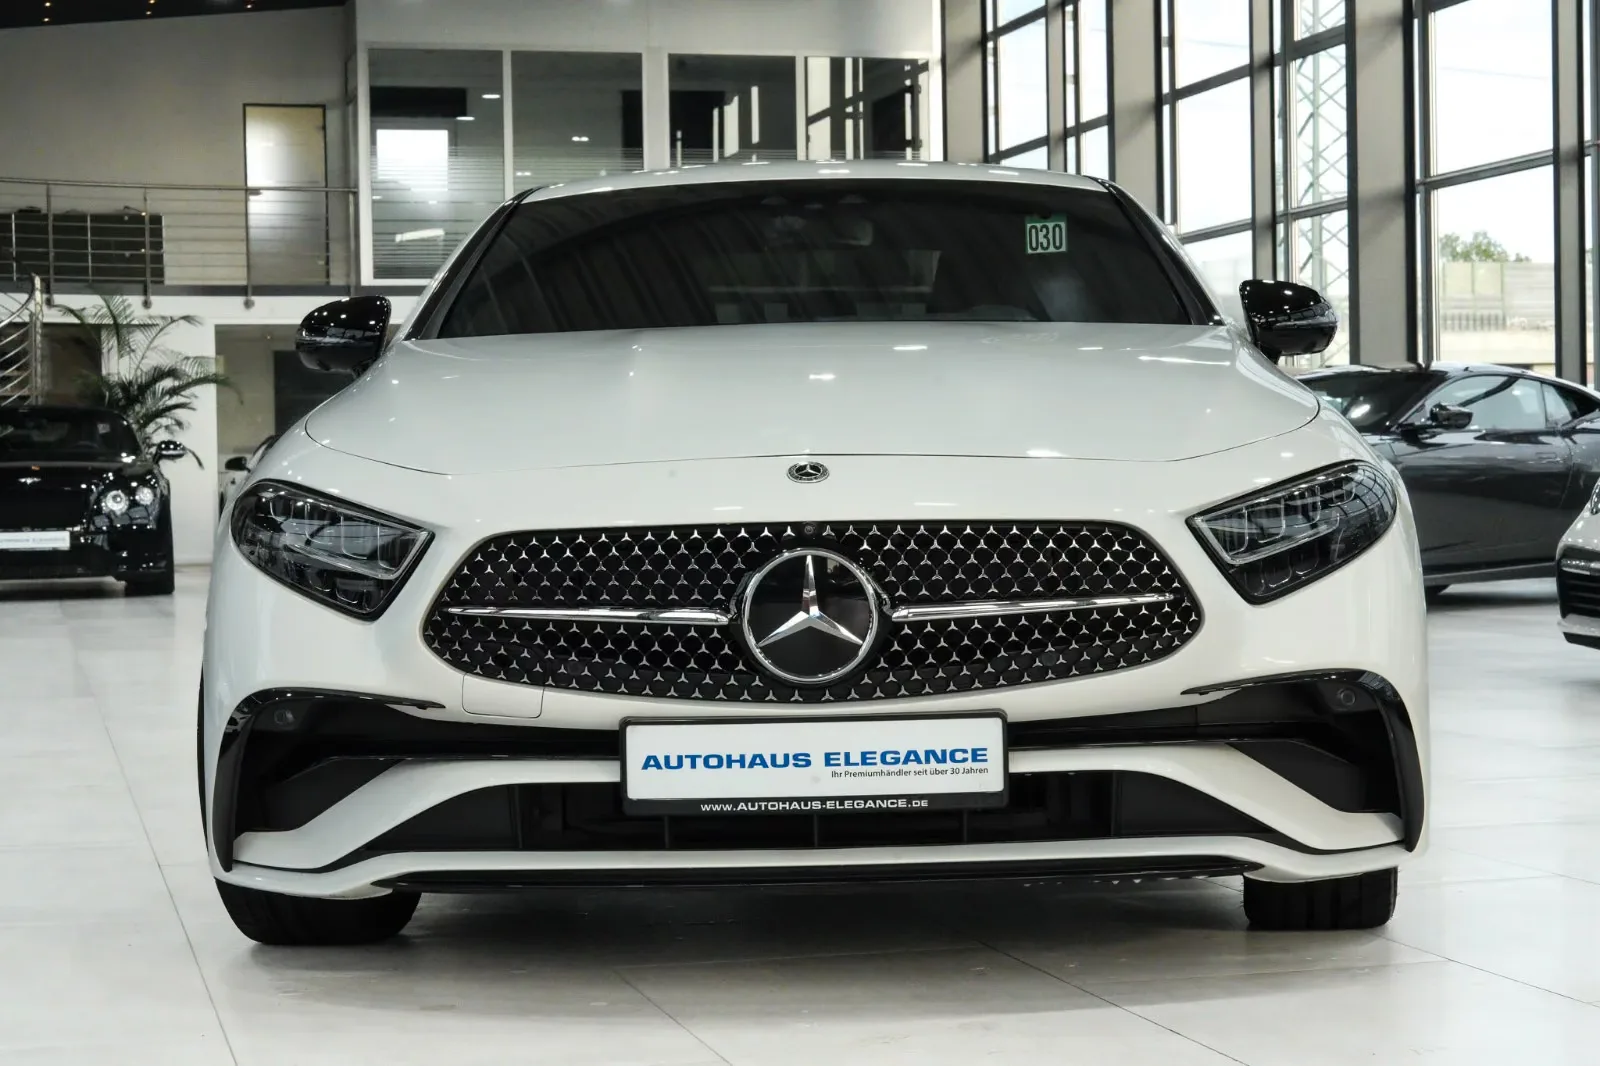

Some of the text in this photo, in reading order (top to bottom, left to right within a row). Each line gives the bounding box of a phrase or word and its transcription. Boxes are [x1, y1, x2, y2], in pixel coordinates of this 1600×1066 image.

[1028, 223, 1063, 252] 030
[641, 748, 988, 770] AUTOHAUS ELEGANCE
[831, 767, 989, 778] Ihr Premiumhändler seit über 30 Jahren
[700, 799, 929, 812] www.AUTOHAUS-ELEGANCE.DE
